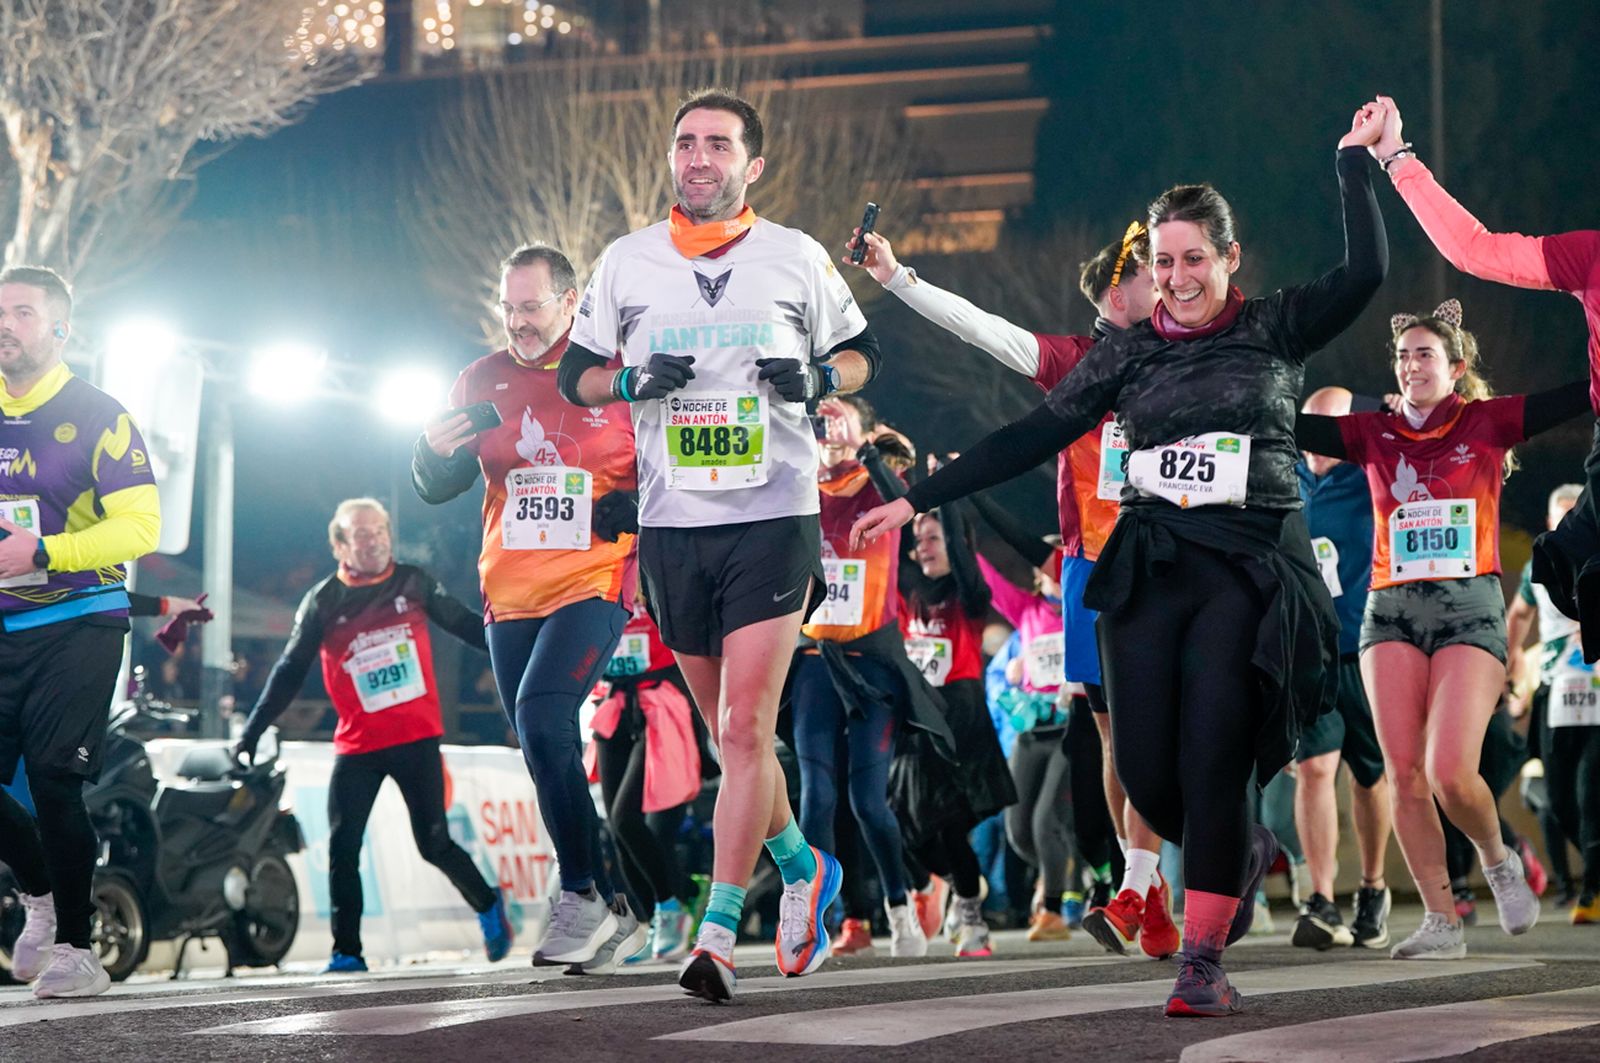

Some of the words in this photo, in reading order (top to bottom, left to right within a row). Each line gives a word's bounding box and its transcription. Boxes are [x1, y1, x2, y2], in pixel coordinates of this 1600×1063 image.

[682, 402, 712, 412] NOCHE
[716, 402, 728, 412] DE
[672, 414, 690, 425] SAN
[692, 411, 728, 425] ANTÓN
[680, 426, 749, 456] 8483
[1160, 449, 1215, 483] 825
[524, 475, 545, 485] NOCHE
[547, 475, 557, 484] DE
[1159, 481, 1198, 492] FRANCISAC
[1200, 485, 1213, 493] EVA
[515, 486, 529, 496] SAN
[530, 483, 558, 495] ANTÓN
[516, 496, 574, 521] 3593
[1408, 509, 1430, 518] NOCHE
[1432, 508, 1442, 517] DE
[1399, 519, 1415, 530] SAN
[1415, 516, 1443, 529] ANTÓN
[1406, 527, 1458, 553] 8150
[367, 662, 409, 689] 9291
[482, 801, 538, 845] SAN
